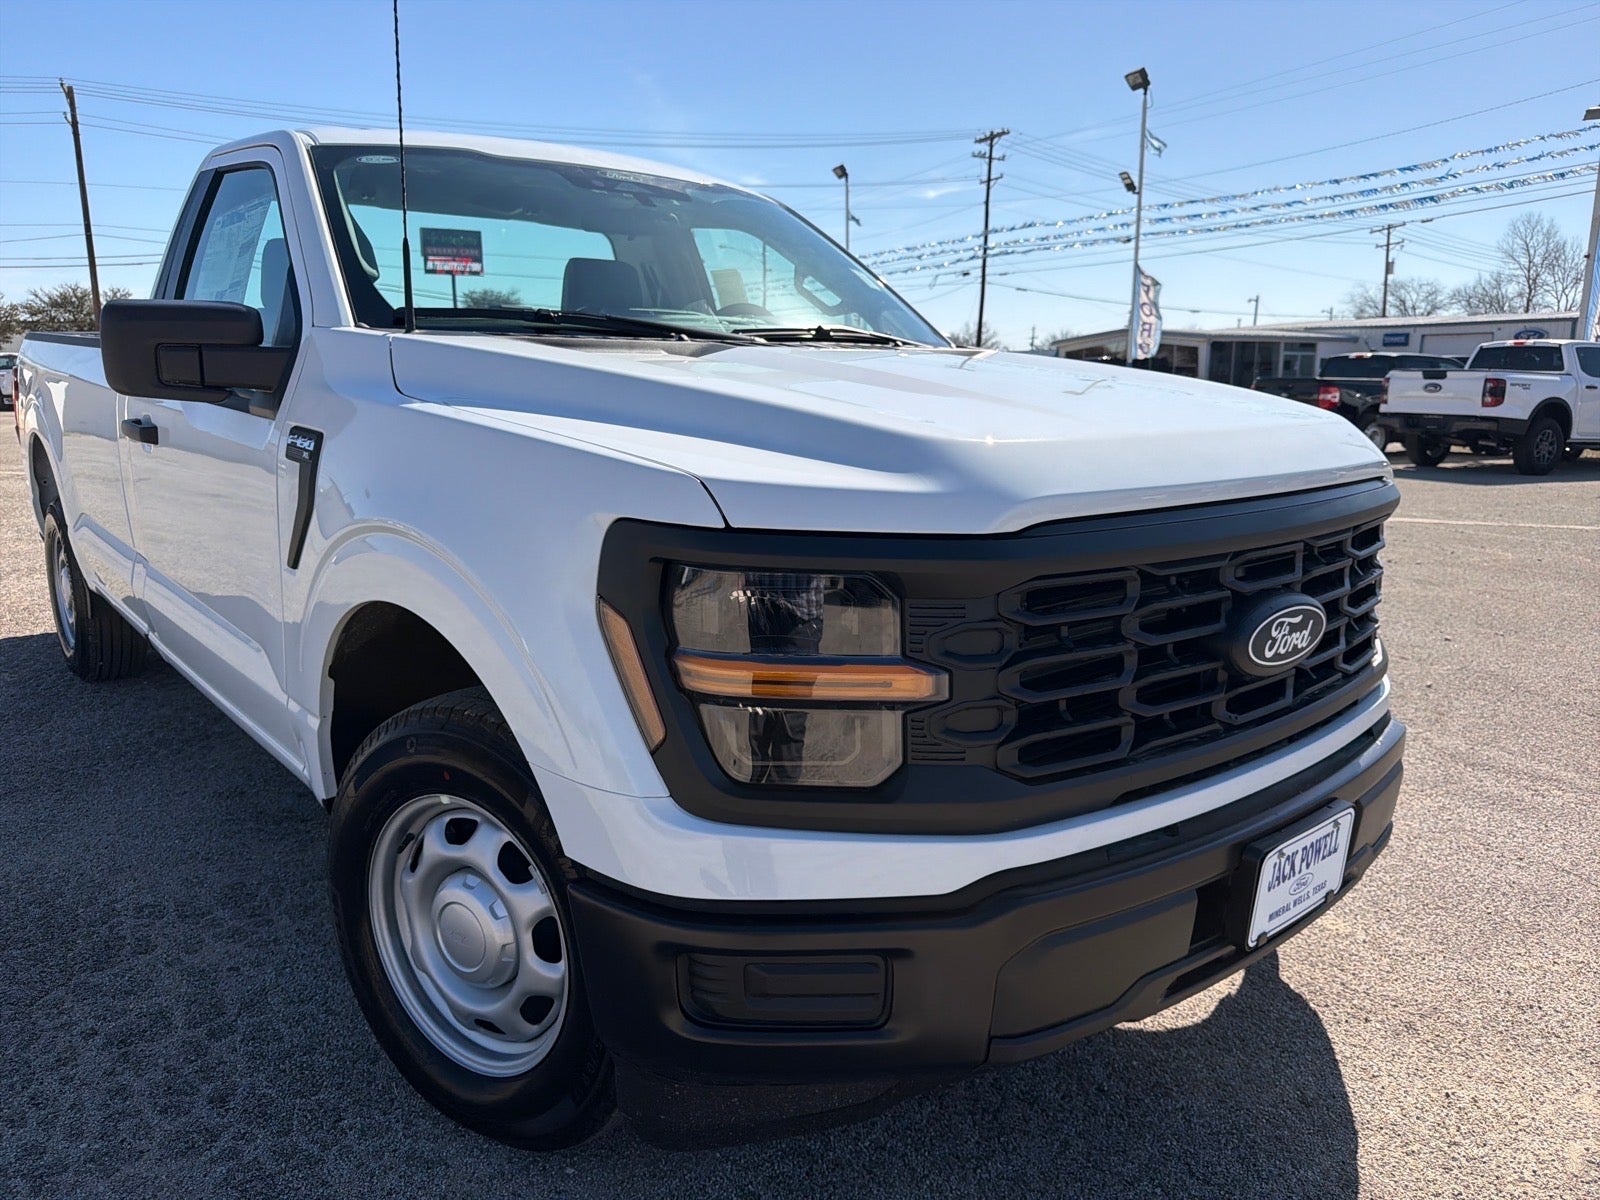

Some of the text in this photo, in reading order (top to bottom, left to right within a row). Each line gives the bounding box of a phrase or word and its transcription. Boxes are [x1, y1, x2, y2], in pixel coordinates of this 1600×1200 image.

[1264, 614, 1314, 659] Ford
[1267, 826, 1340, 893] JACK POWELL
[1268, 903, 1292, 923] MINERAL
[1312, 880, 1328, 897] TEXAS
